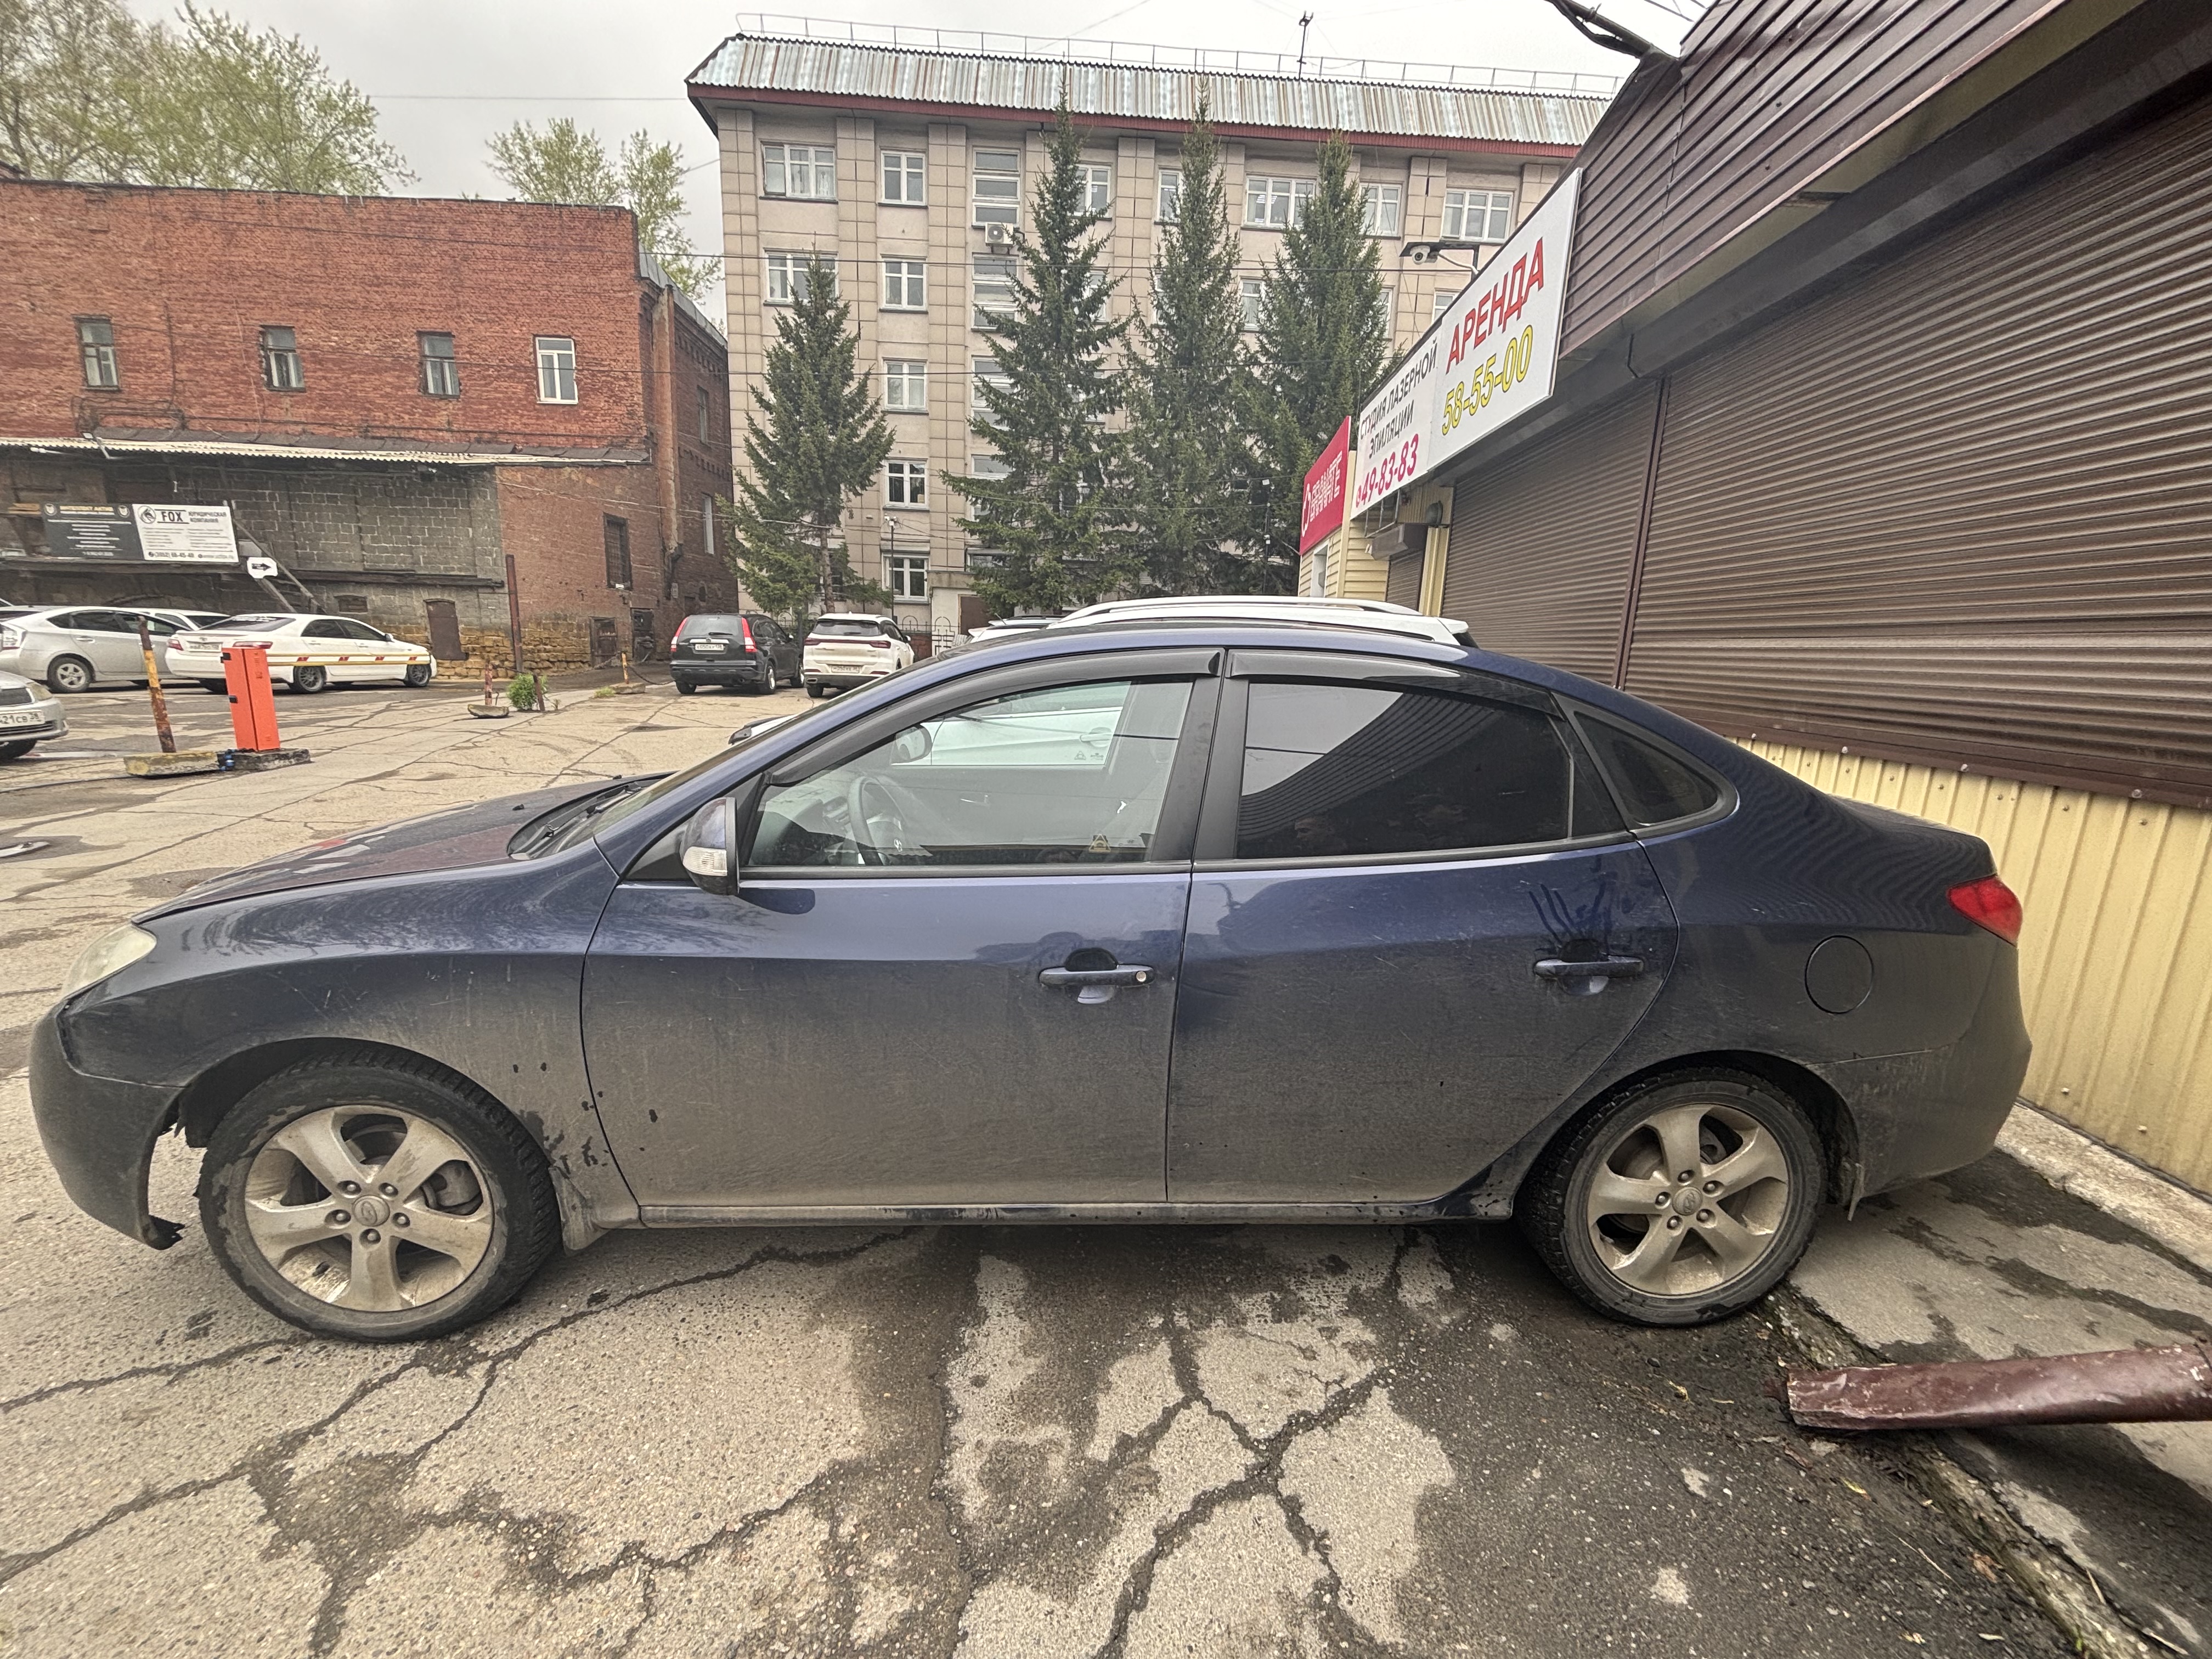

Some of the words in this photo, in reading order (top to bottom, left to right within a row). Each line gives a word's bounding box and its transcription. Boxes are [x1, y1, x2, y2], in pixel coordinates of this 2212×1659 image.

[1446, 236, 1544, 375] АРЕНДА
[1361, 396, 1387, 439] СТУДИЯ
[1387, 336, 1437, 414] ЛАЗЕРНОЙ
[1442, 325, 1533, 436] 58-55-00
[1362, 433, 1419, 505] 49-83-83
[1369, 399, 1414, 459] ЭПИЛЯЦИИ
[161, 511, 183, 522] FOX
